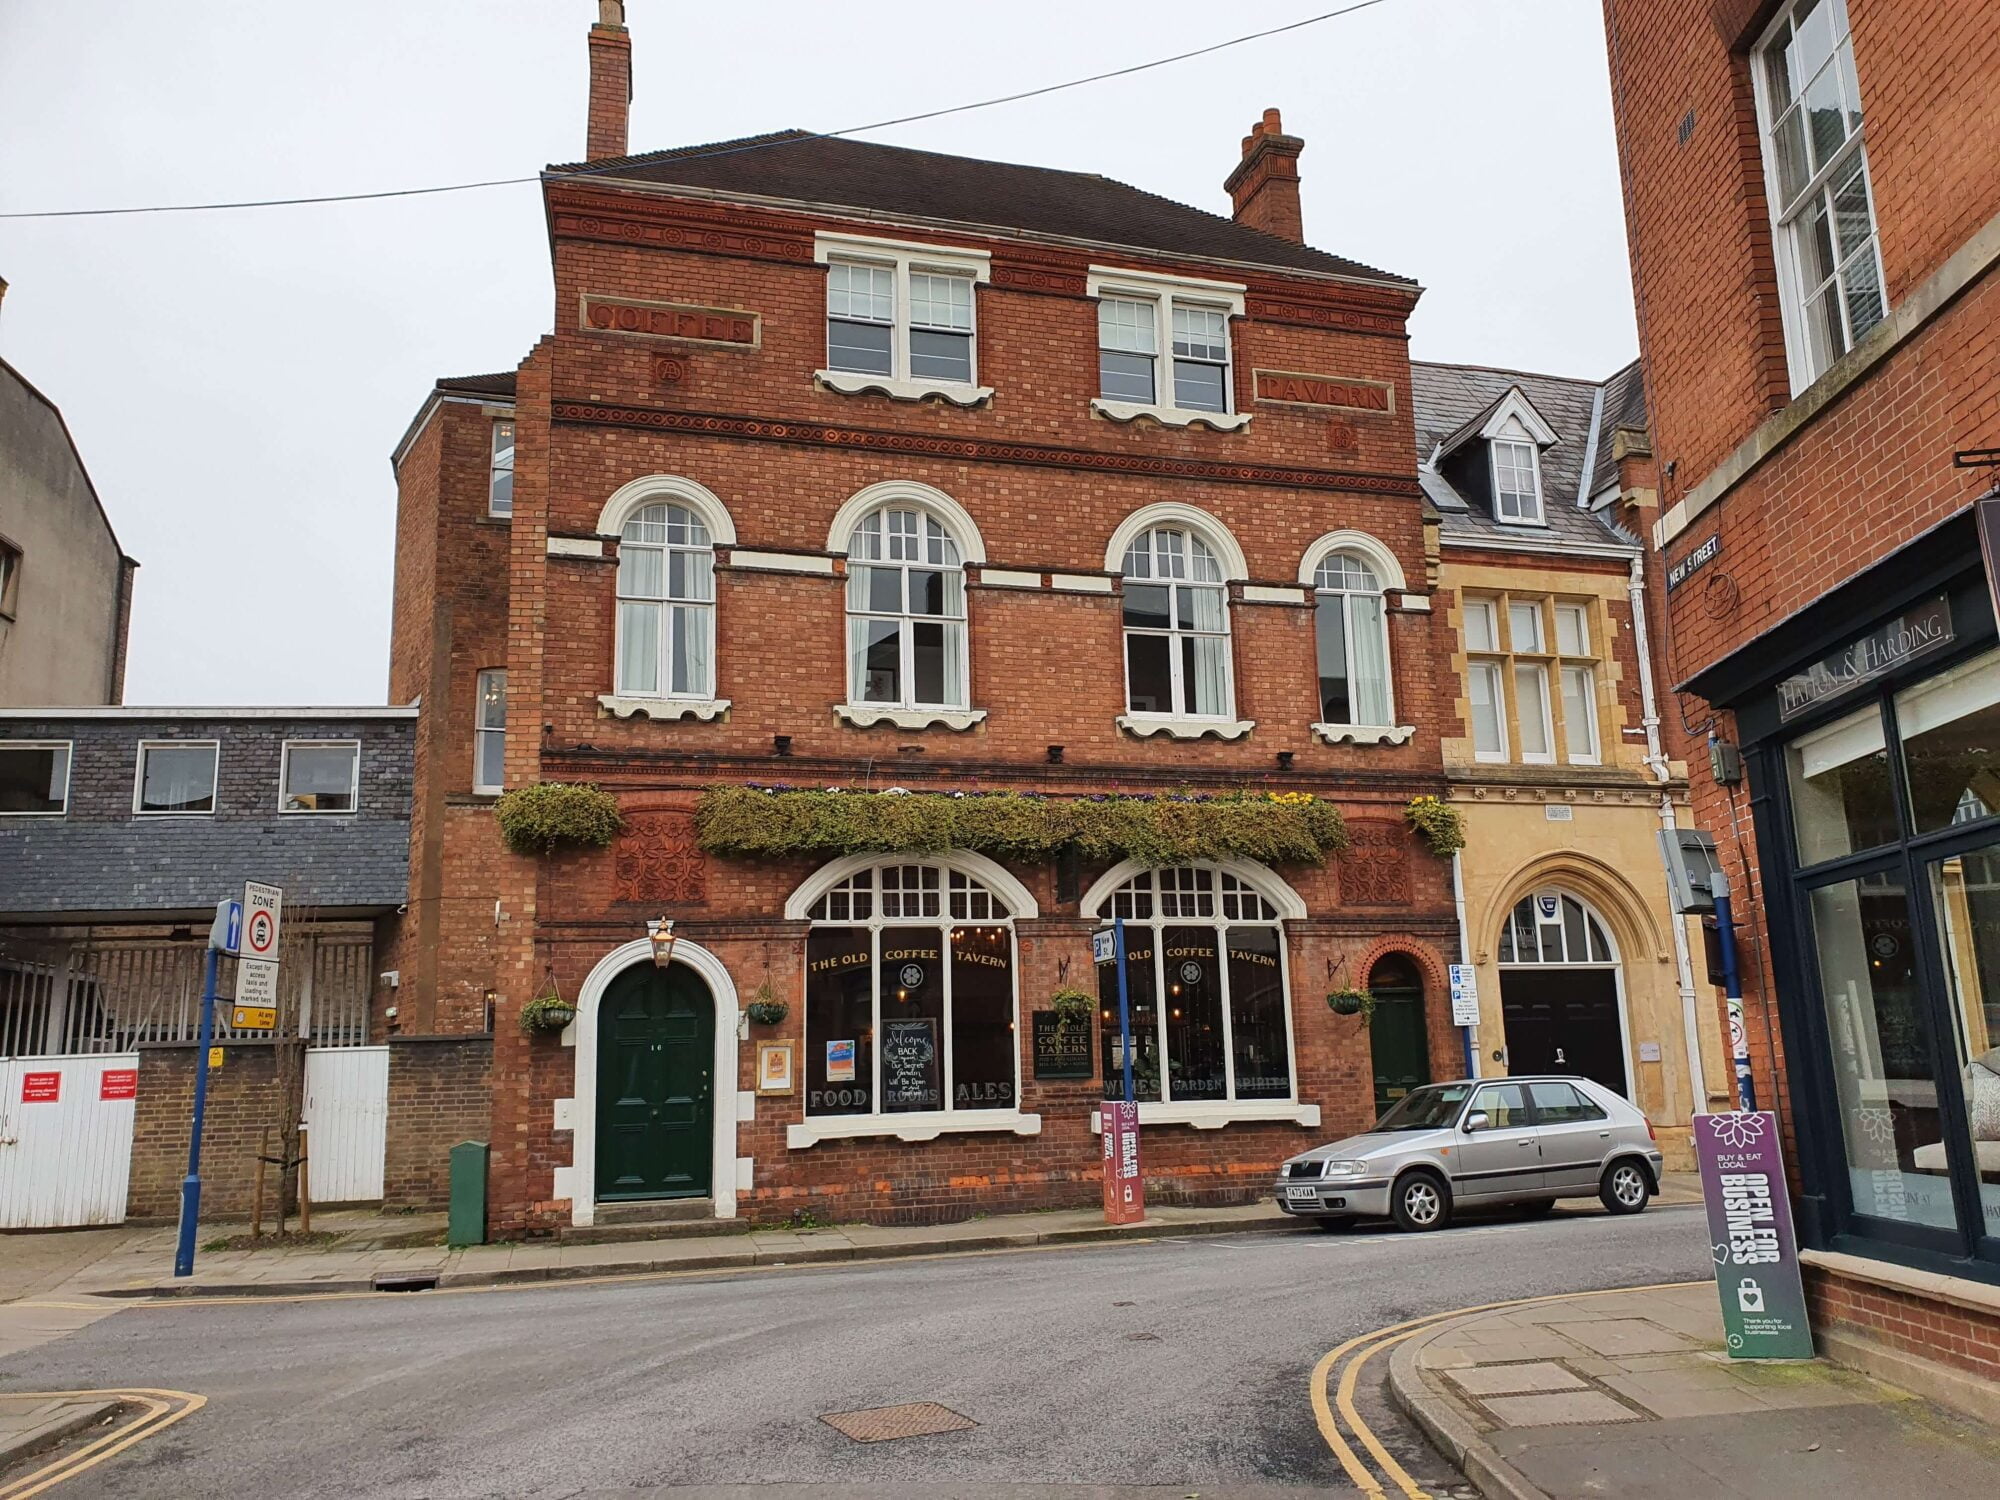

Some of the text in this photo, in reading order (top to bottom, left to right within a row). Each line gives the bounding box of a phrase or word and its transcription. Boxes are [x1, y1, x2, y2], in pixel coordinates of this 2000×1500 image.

[594, 305, 751, 342] COFFEE
[1259, 377, 1387, 410] TAVERN
[1669, 535, 1717, 587] NEW STREET
[1843, 651, 1861, 680] &
[1863, 614, 1942, 671] HARDING
[248, 884, 279, 897] PEDESTRIAN
[252, 895, 275, 908] ZONE
[810, 949, 1007, 972] THE OLD COFFEE TAVERN
[1128, 947, 1277, 967] OLD COFFEE TAVERN
[887, 1029, 929, 1047] Welcome
[1038, 1024, 1056, 1032] THE
[1038, 1035, 1088, 1045] COFEE
[897, 1047, 918, 1056] BACK
[911, 1078, 926, 1086] Open
[1172, 1079, 1222, 1092] GARDEN
[1235, 1077, 1290, 1090] SPIRITS
[810, 1082, 1012, 1108] FOOD ROOMS ALES
[1129, 1132, 1137, 1156] OPEN
[1121, 1132, 1131, 1179] BUSINESS
[1717, 1154, 1735, 1162] BUY
[1746, 1153, 1762, 1161] EAT
[1718, 1161, 1747, 1169] LOCAL
[1720, 1174, 1759, 1265] BUSINESS
[1745, 1173, 1780, 1263] OPEN FOR
